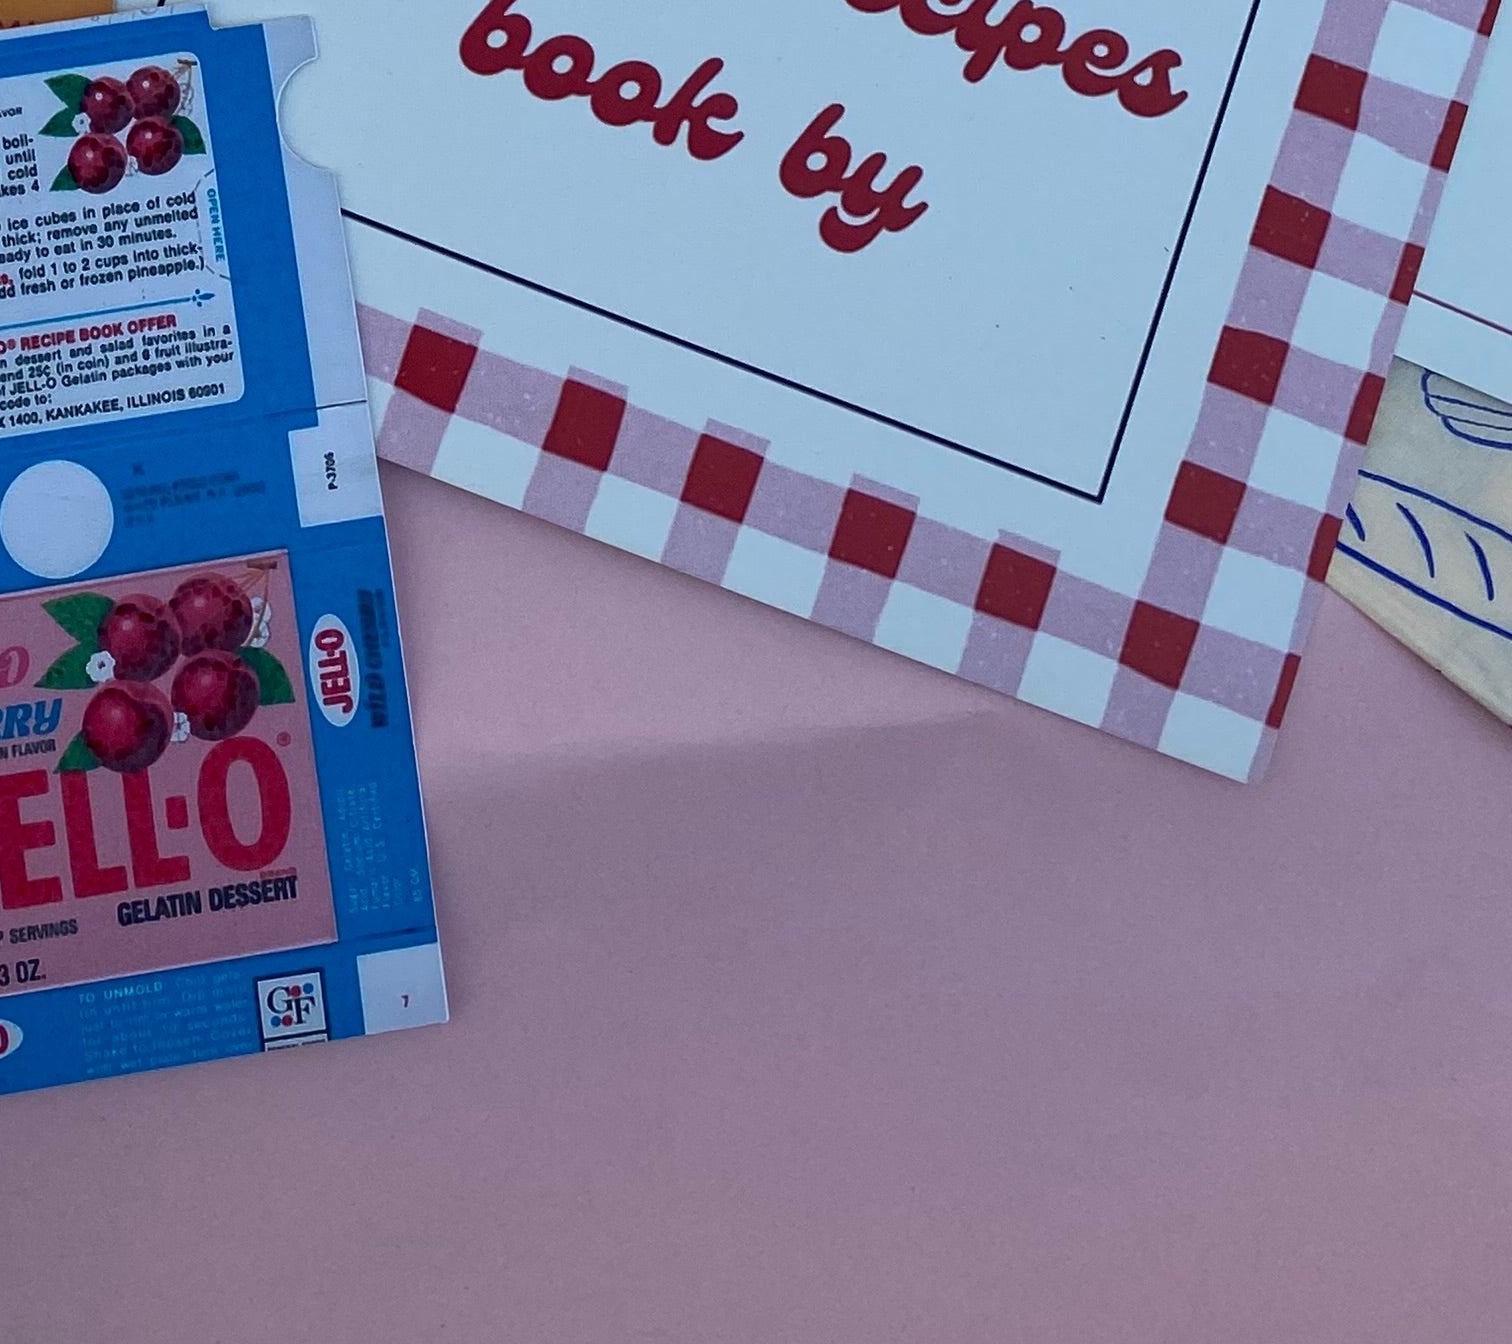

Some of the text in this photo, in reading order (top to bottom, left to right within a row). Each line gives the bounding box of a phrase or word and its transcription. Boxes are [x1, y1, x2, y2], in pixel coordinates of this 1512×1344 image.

[5, 148, 36, 165] until
[7, 163, 38, 180] cold
[779, 103, 928, 253] by
[207, 187, 226, 262] OPEN HERE
[20, 314, 177, 351] RECIPE OFFER
[126, 388, 185, 408] ILLINOIS
[11, 738, 56, 758] FLAVOR
[117, 874, 297, 926] GELATIN DESSERT
[9, 918, 78, 944] SERVINGS
[15, 958, 46, 983] OZ.
